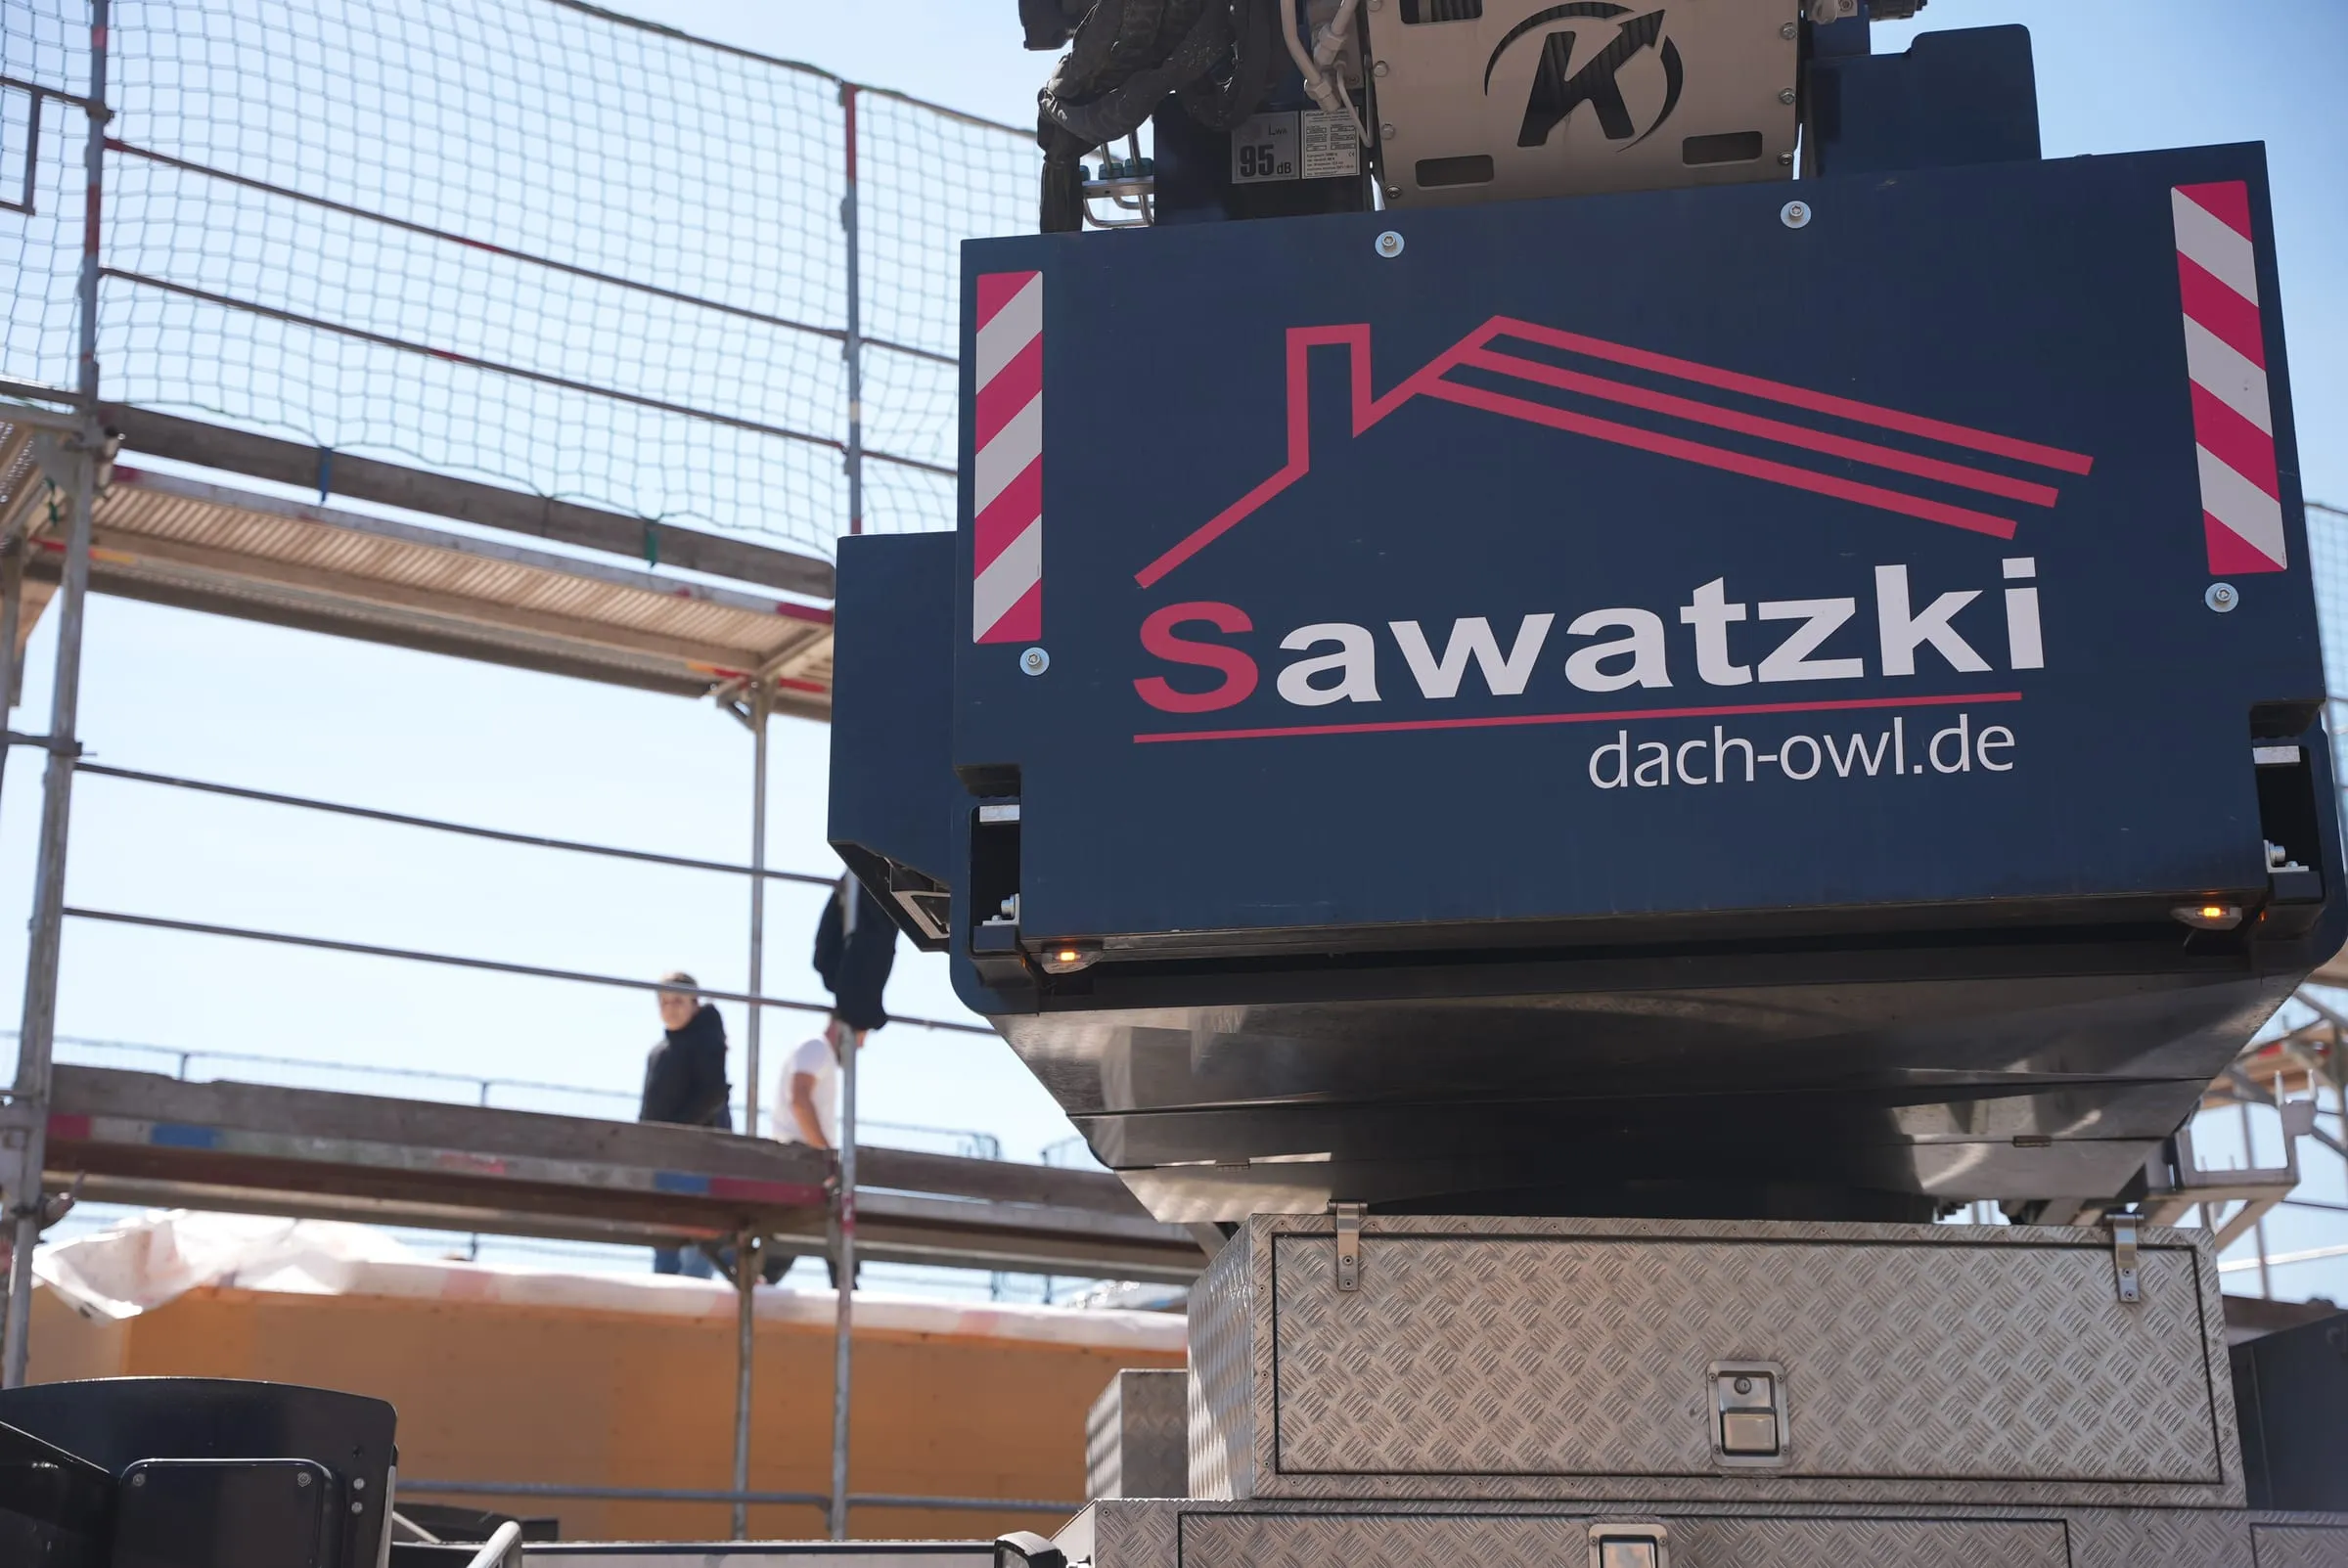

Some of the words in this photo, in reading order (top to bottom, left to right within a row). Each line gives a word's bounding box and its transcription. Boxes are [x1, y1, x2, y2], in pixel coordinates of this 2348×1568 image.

[1516, 9, 1665, 148] K
[1240, 144, 1275, 178] 95
[1277, 161, 1292, 175] dB
[1133, 557, 2045, 714] Sawatzki
[1588, 713, 2016, 789] dach-owl.de
